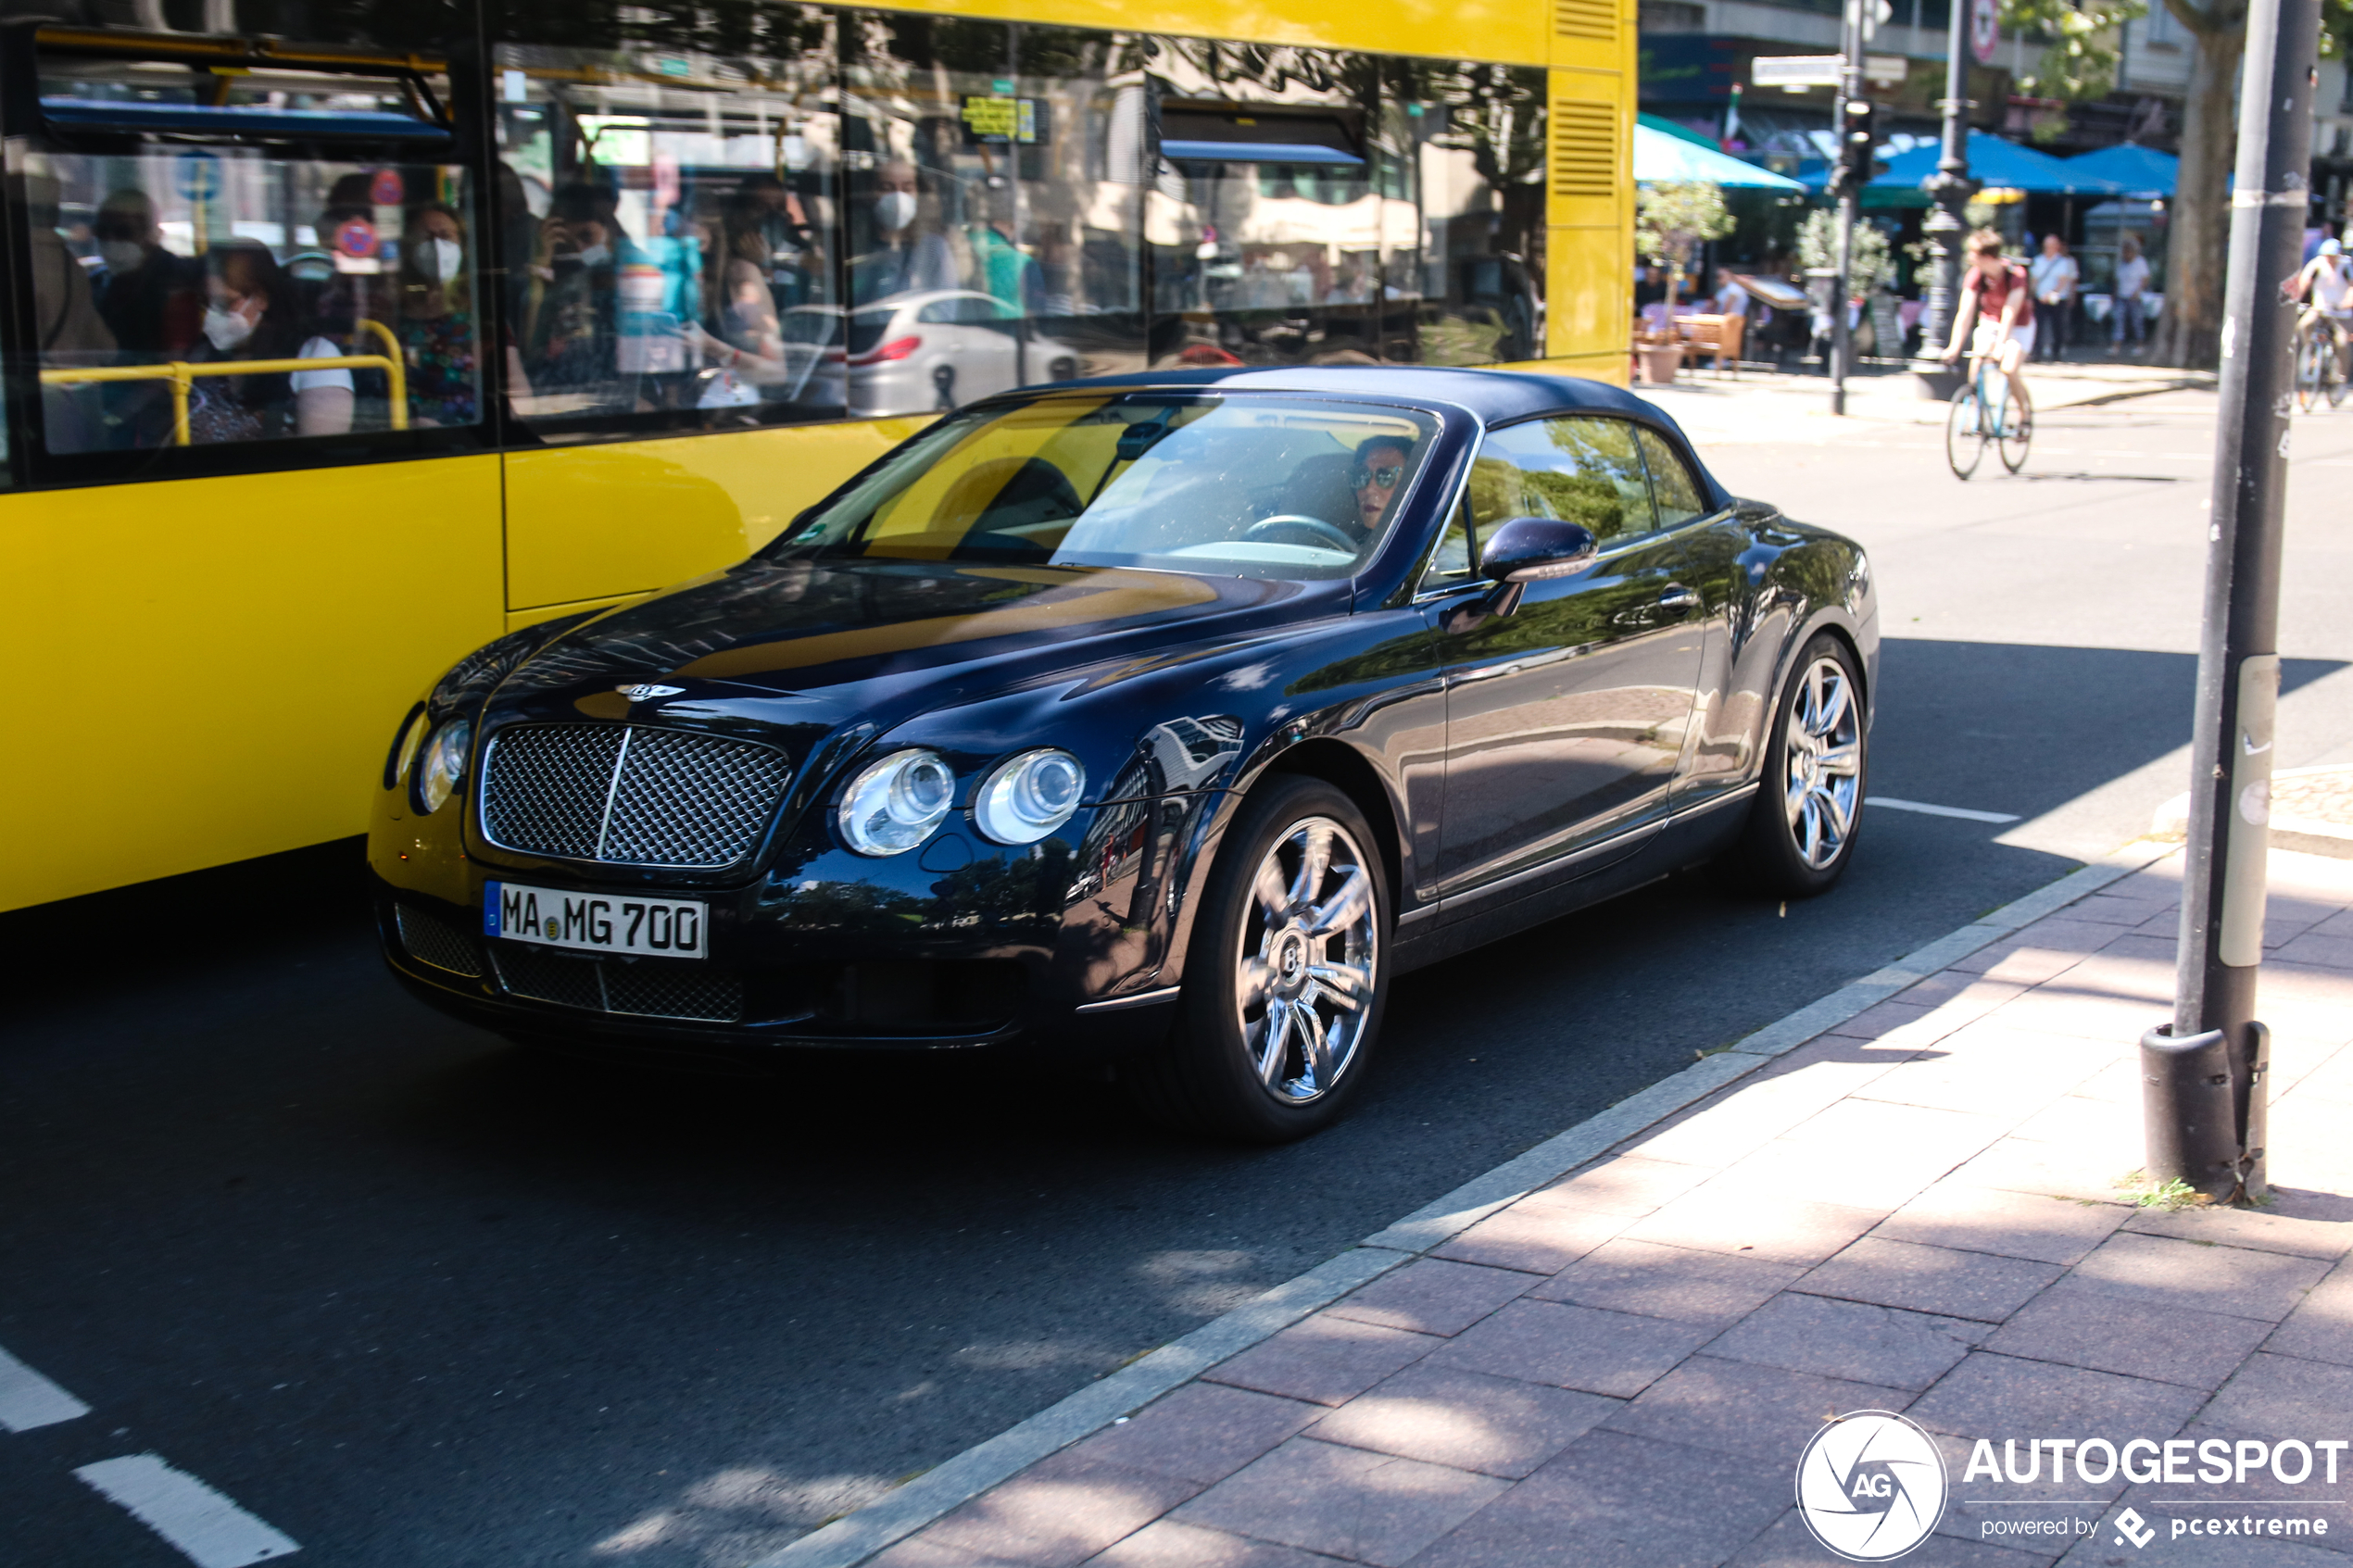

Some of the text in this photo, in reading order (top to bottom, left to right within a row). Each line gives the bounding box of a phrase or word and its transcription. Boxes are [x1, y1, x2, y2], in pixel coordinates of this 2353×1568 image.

[503, 889, 698, 951] MA MG 700
[1284, 947, 1298, 972] B
